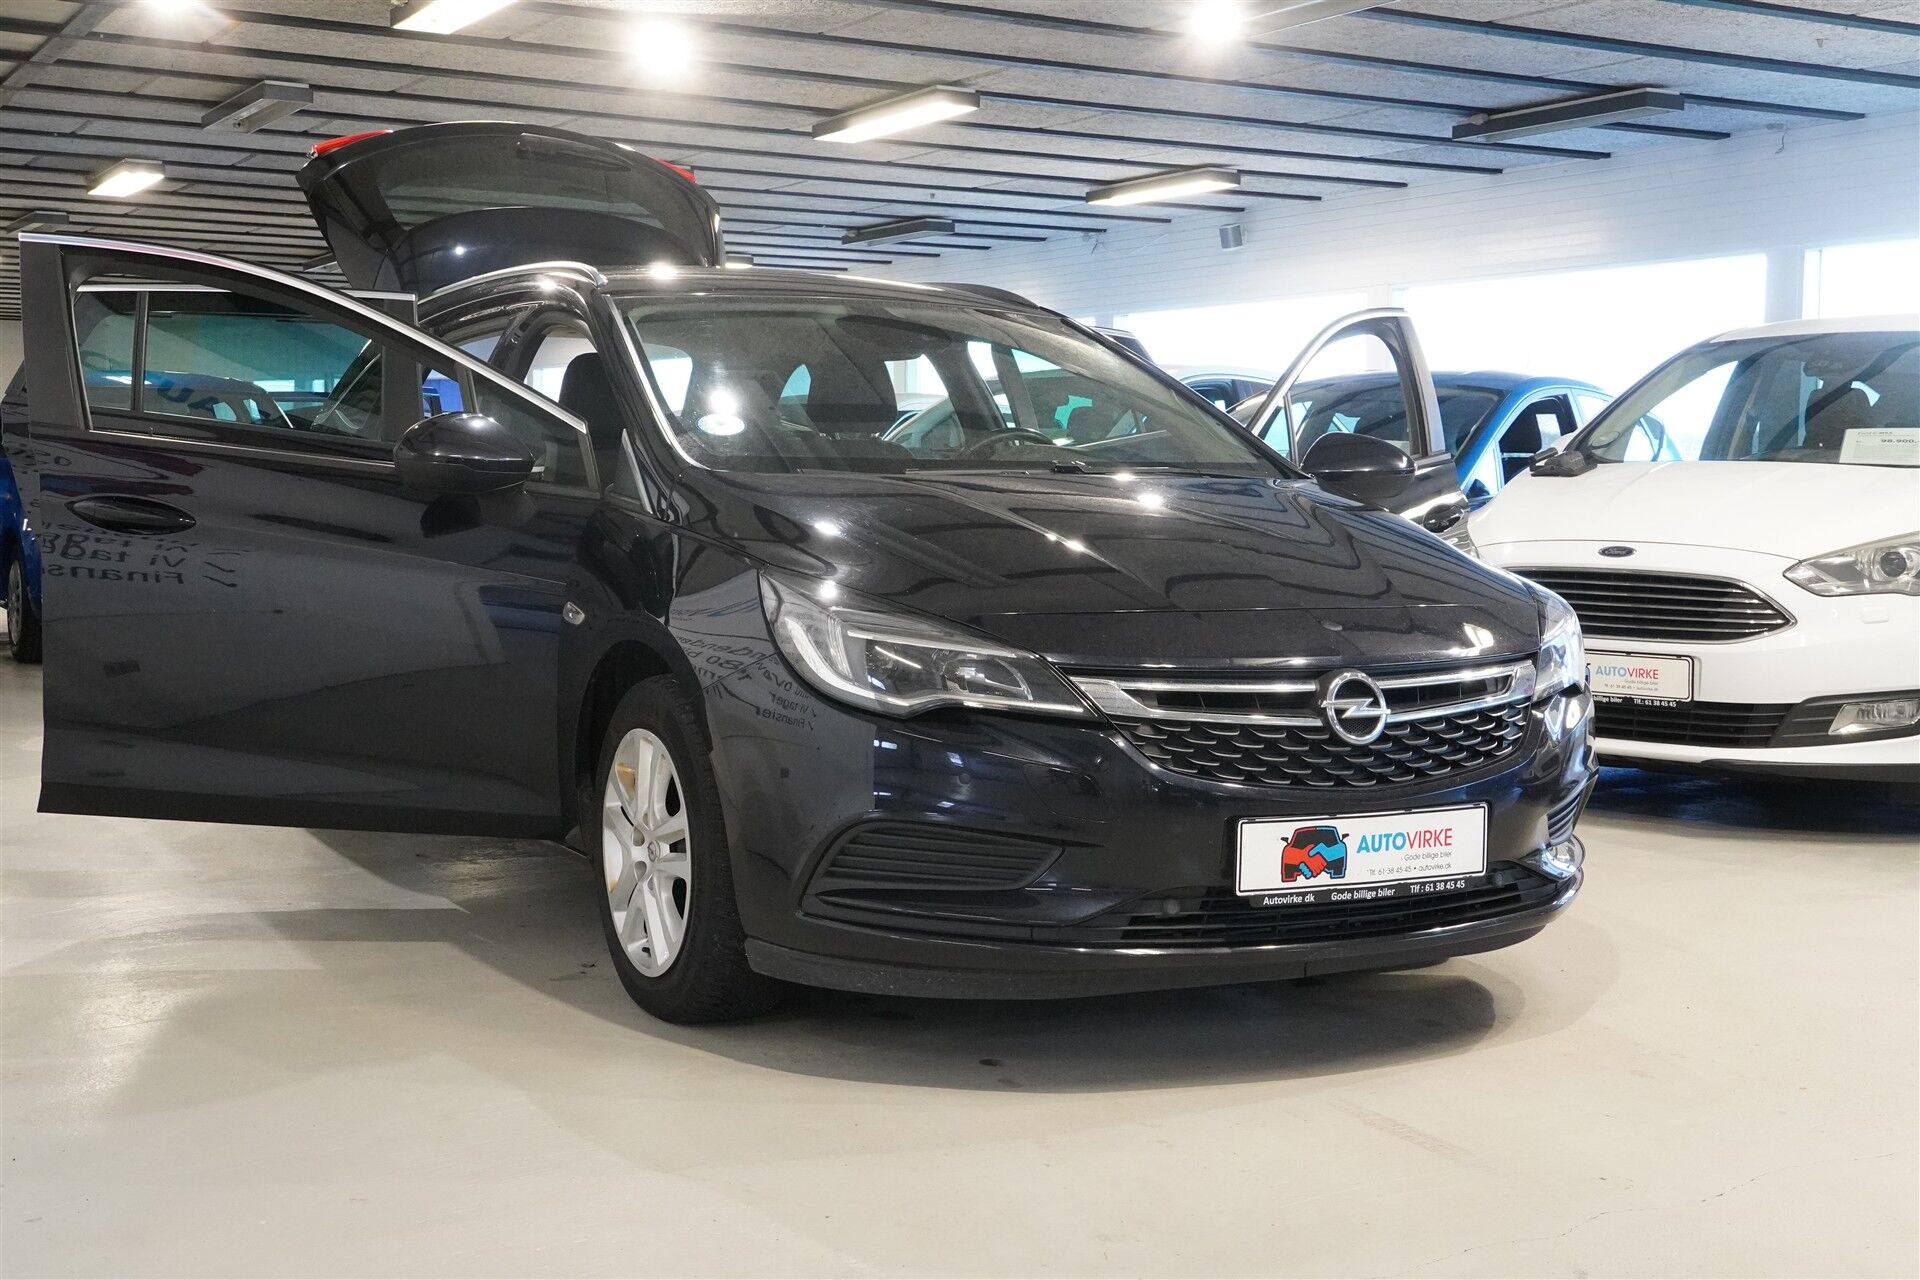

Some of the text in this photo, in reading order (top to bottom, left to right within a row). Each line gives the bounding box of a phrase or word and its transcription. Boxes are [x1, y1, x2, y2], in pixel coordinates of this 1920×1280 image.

[1595, 666, 1659, 680] AUTOVIRKE
[1357, 828, 1453, 853] AUTOVIRKE
[1425, 883, 1434, 892] 61
[1435, 881, 1445, 891] 38
[1446, 880, 1455, 890] 45
[1456, 879, 1466, 889] 45
[1262, 893, 1315, 906] Autovirke dk
[1331, 887, 1396, 902] Gode billige biler
